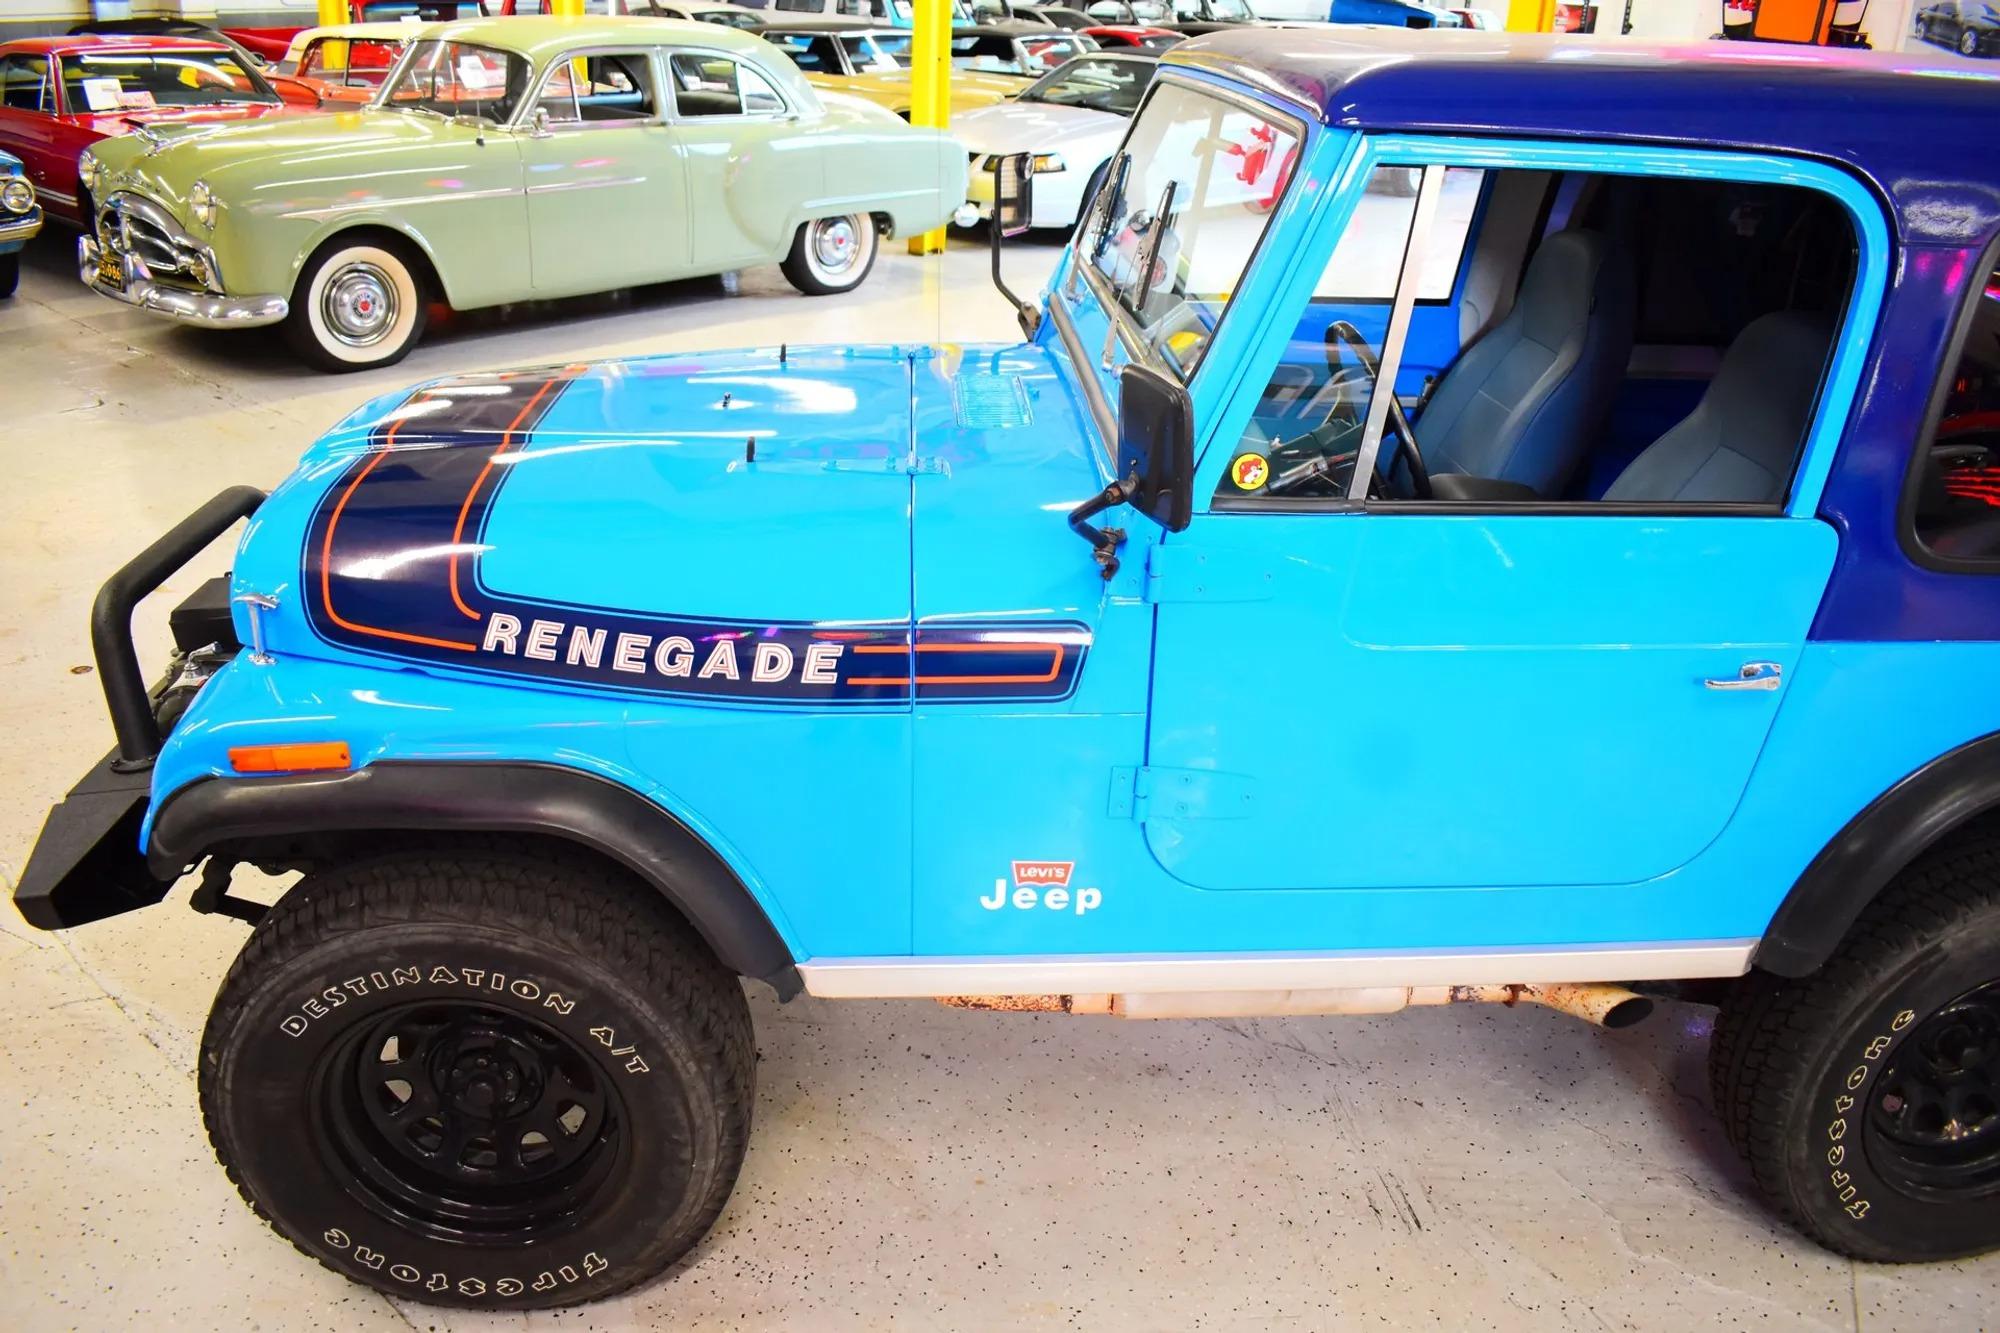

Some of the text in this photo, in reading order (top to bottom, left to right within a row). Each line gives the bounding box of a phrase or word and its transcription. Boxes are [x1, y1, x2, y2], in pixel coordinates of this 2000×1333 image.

[482, 612, 845, 685] RENEGADE
[979, 878, 1103, 916] Jeep
[280, 965, 650, 1074] DESTINATION A/T
